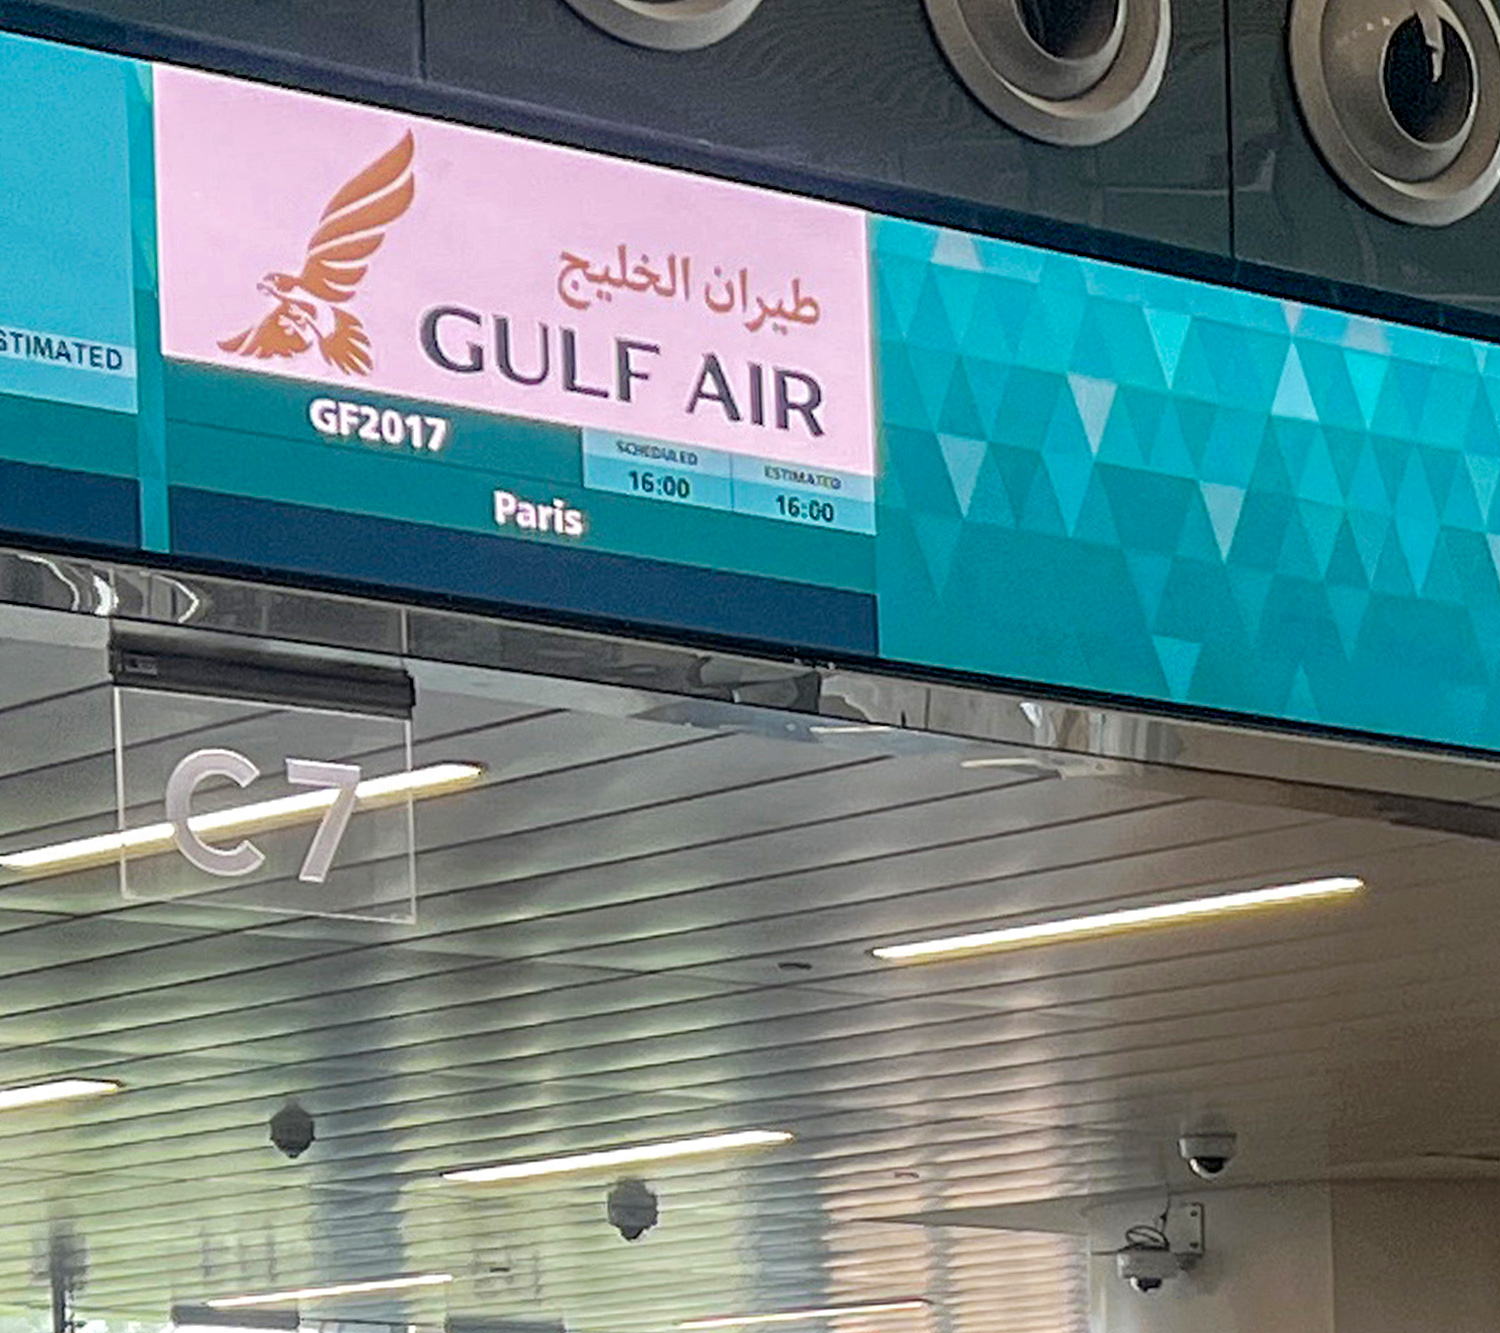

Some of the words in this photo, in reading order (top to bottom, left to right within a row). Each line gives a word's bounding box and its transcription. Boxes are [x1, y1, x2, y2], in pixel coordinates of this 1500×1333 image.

[558, 244, 691, 310] الخليج
[705, 268, 820, 333] طيران
[419, 304, 660, 407] GULF
[685, 351, 825, 438] AIR
[310, 397, 448, 452] GF2017
[616, 440, 698, 466] SCHEDULED
[764, 464, 841, 490] ESTIMATED
[493, 490, 584, 538] Paris
[628, 470, 690, 499] 16:00
[776, 495, 834, 523] 16:00
[164, 748, 362, 883] C7
